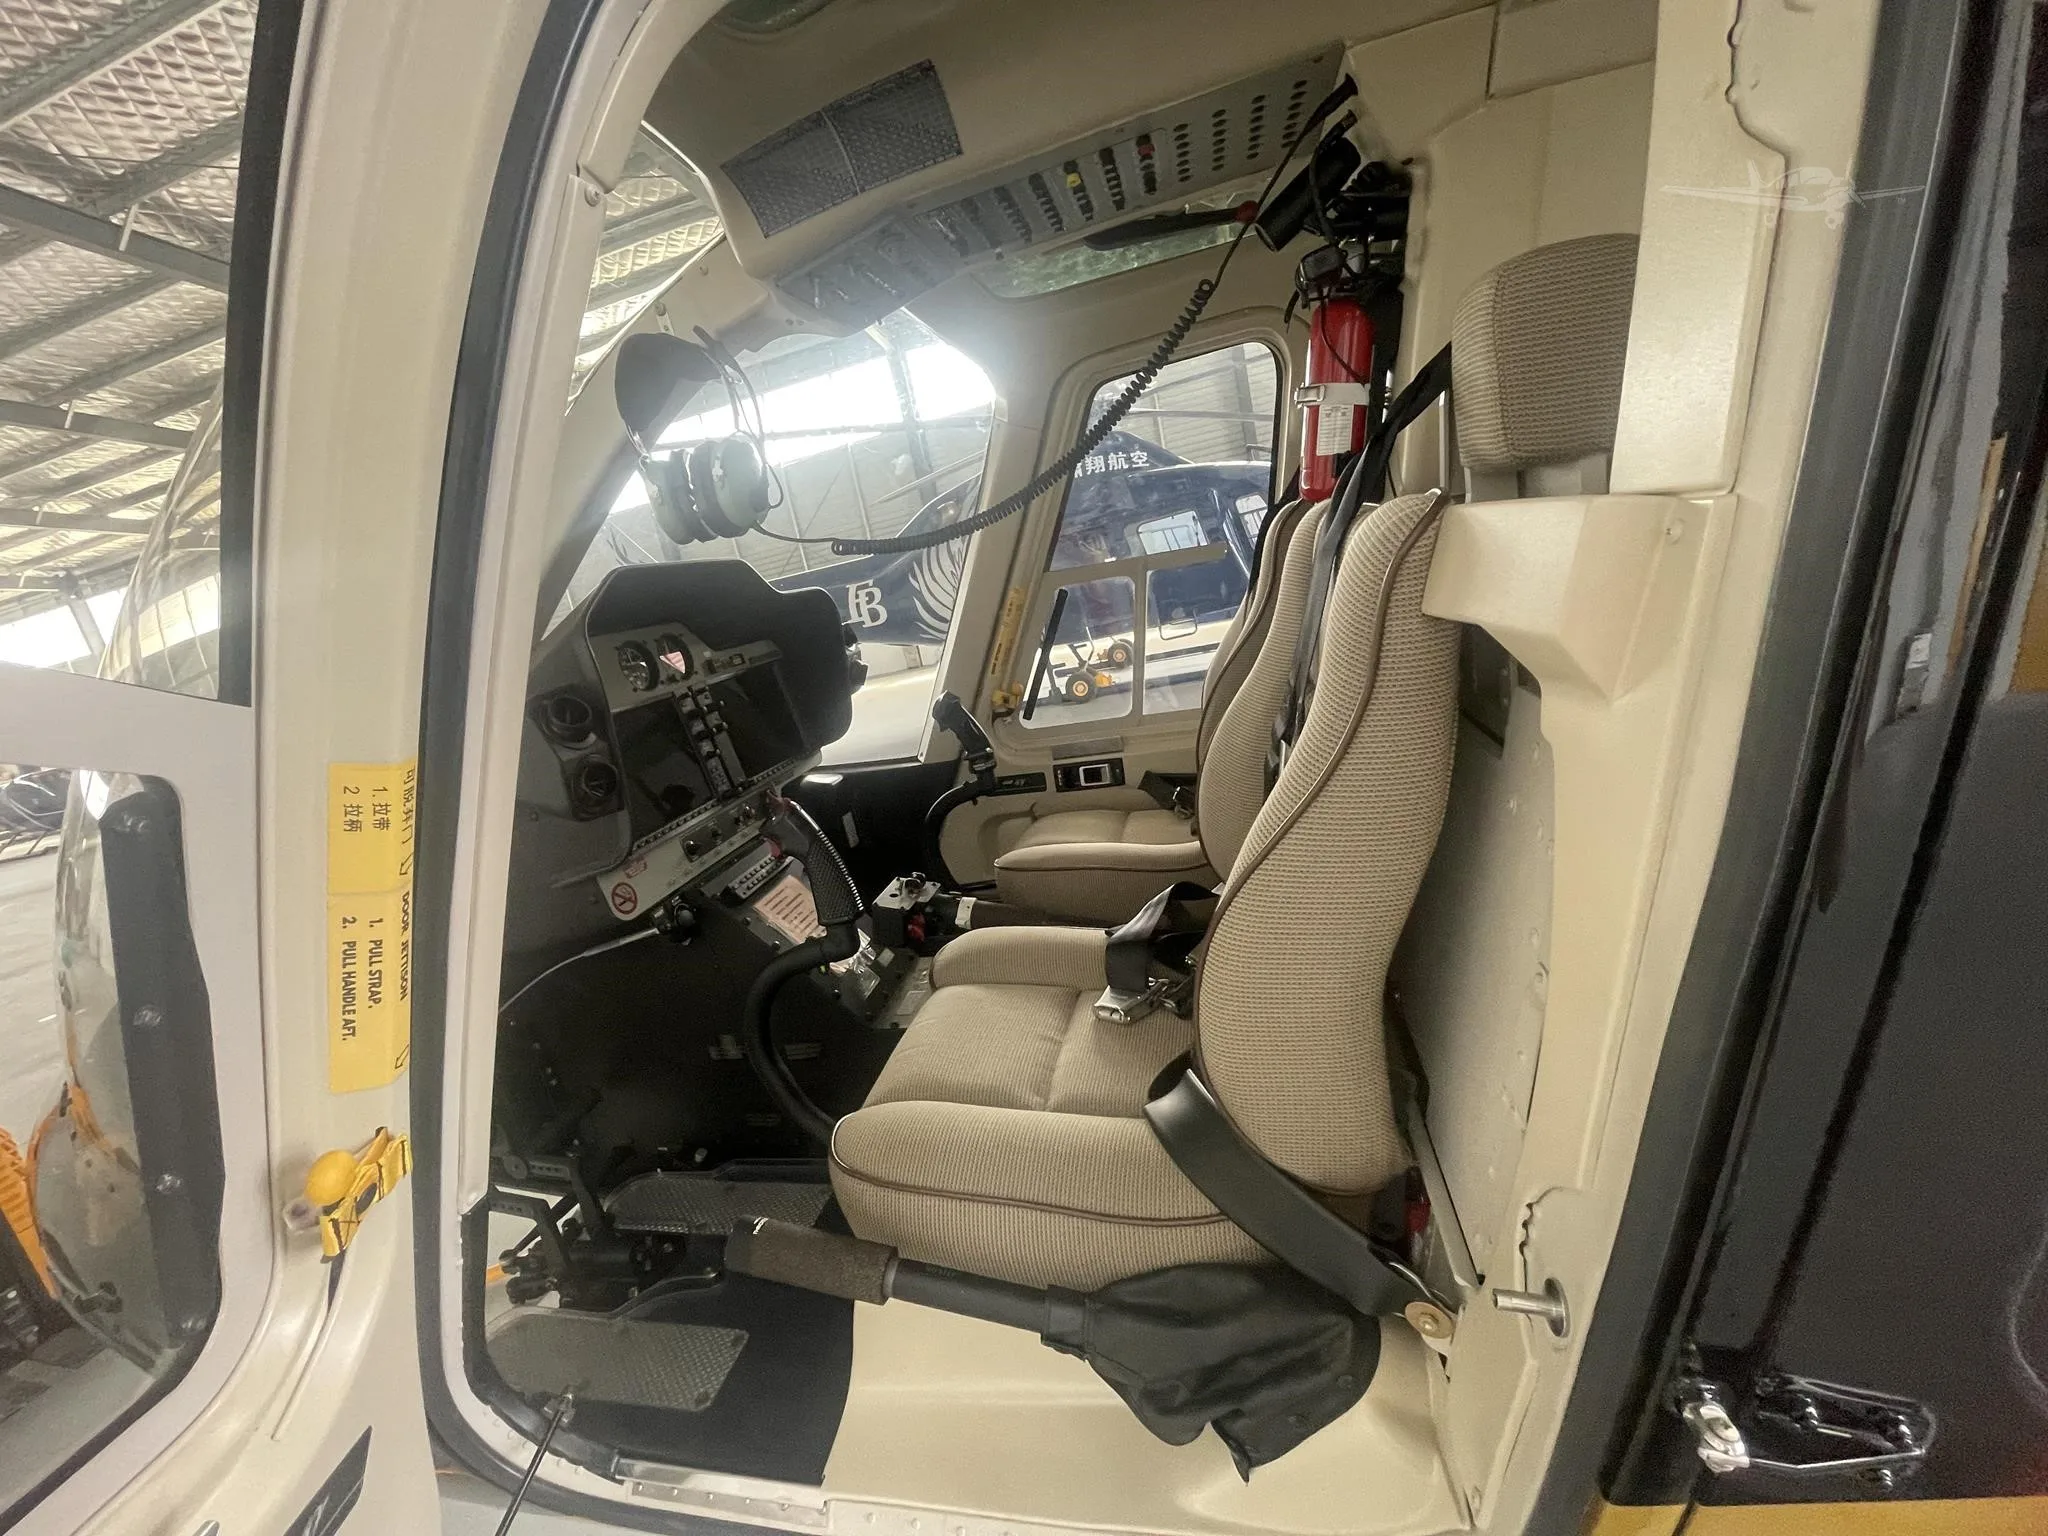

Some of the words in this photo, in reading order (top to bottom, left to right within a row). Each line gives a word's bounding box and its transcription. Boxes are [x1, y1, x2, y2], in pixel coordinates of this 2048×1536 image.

[343, 803, 364, 833] 拉柄
[371, 802, 392, 832] 拉带
[341, 916, 357, 929] 2.
[368, 917, 384, 928] 1.
[401, 891, 410, 936] DOOR
[341, 940, 357, 969] PULL
[368, 939, 384, 967] PULL
[400, 940, 410, 1001] JETTISON
[341, 971, 357, 1016] HANDLE
[367, 969, 383, 1009] STRAP.
[341, 1018, 356, 1041] AFT.
